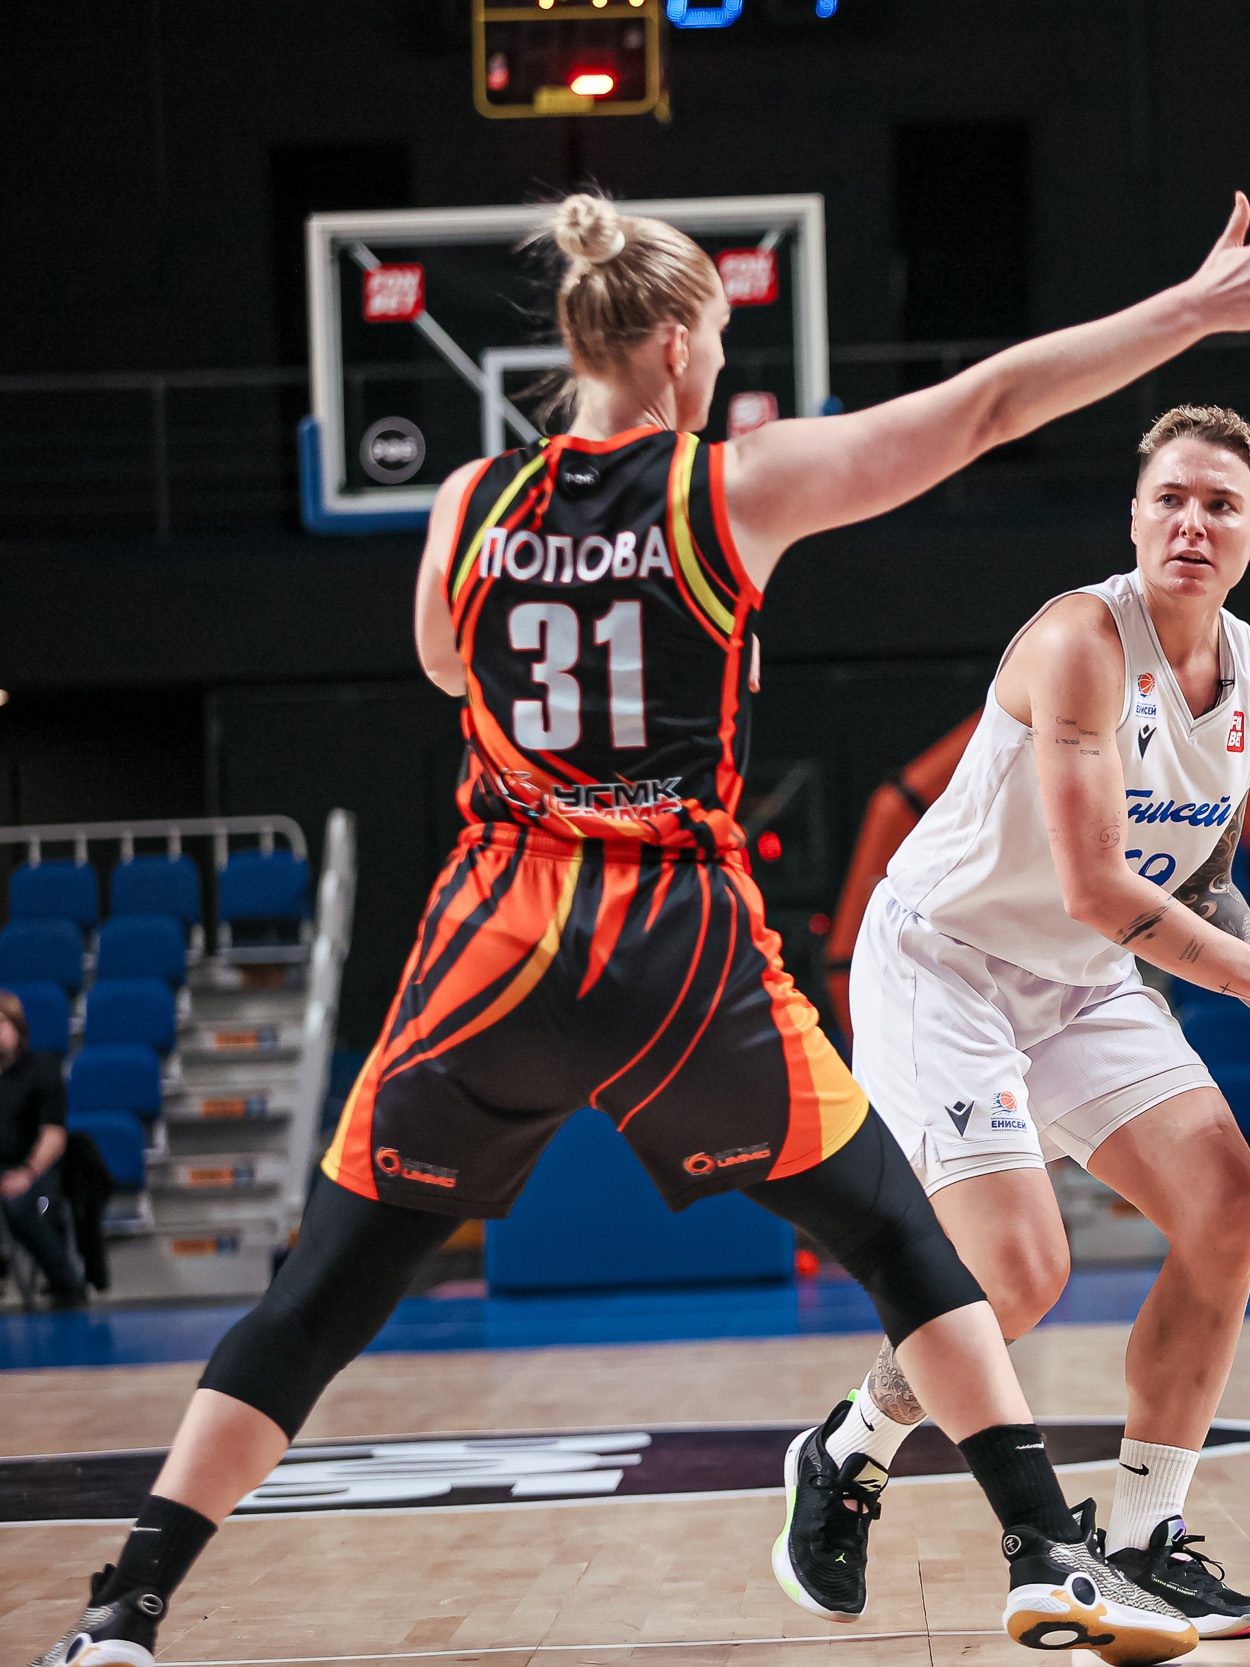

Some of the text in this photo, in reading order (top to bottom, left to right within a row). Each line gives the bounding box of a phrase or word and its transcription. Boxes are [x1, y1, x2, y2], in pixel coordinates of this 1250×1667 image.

[479, 526, 675, 583] ПОПОВА
[508, 601, 648, 750] 31
[552, 777, 684, 809] УГМК
[991, 1119, 1027, 1130] ЕНИСЕЙ
